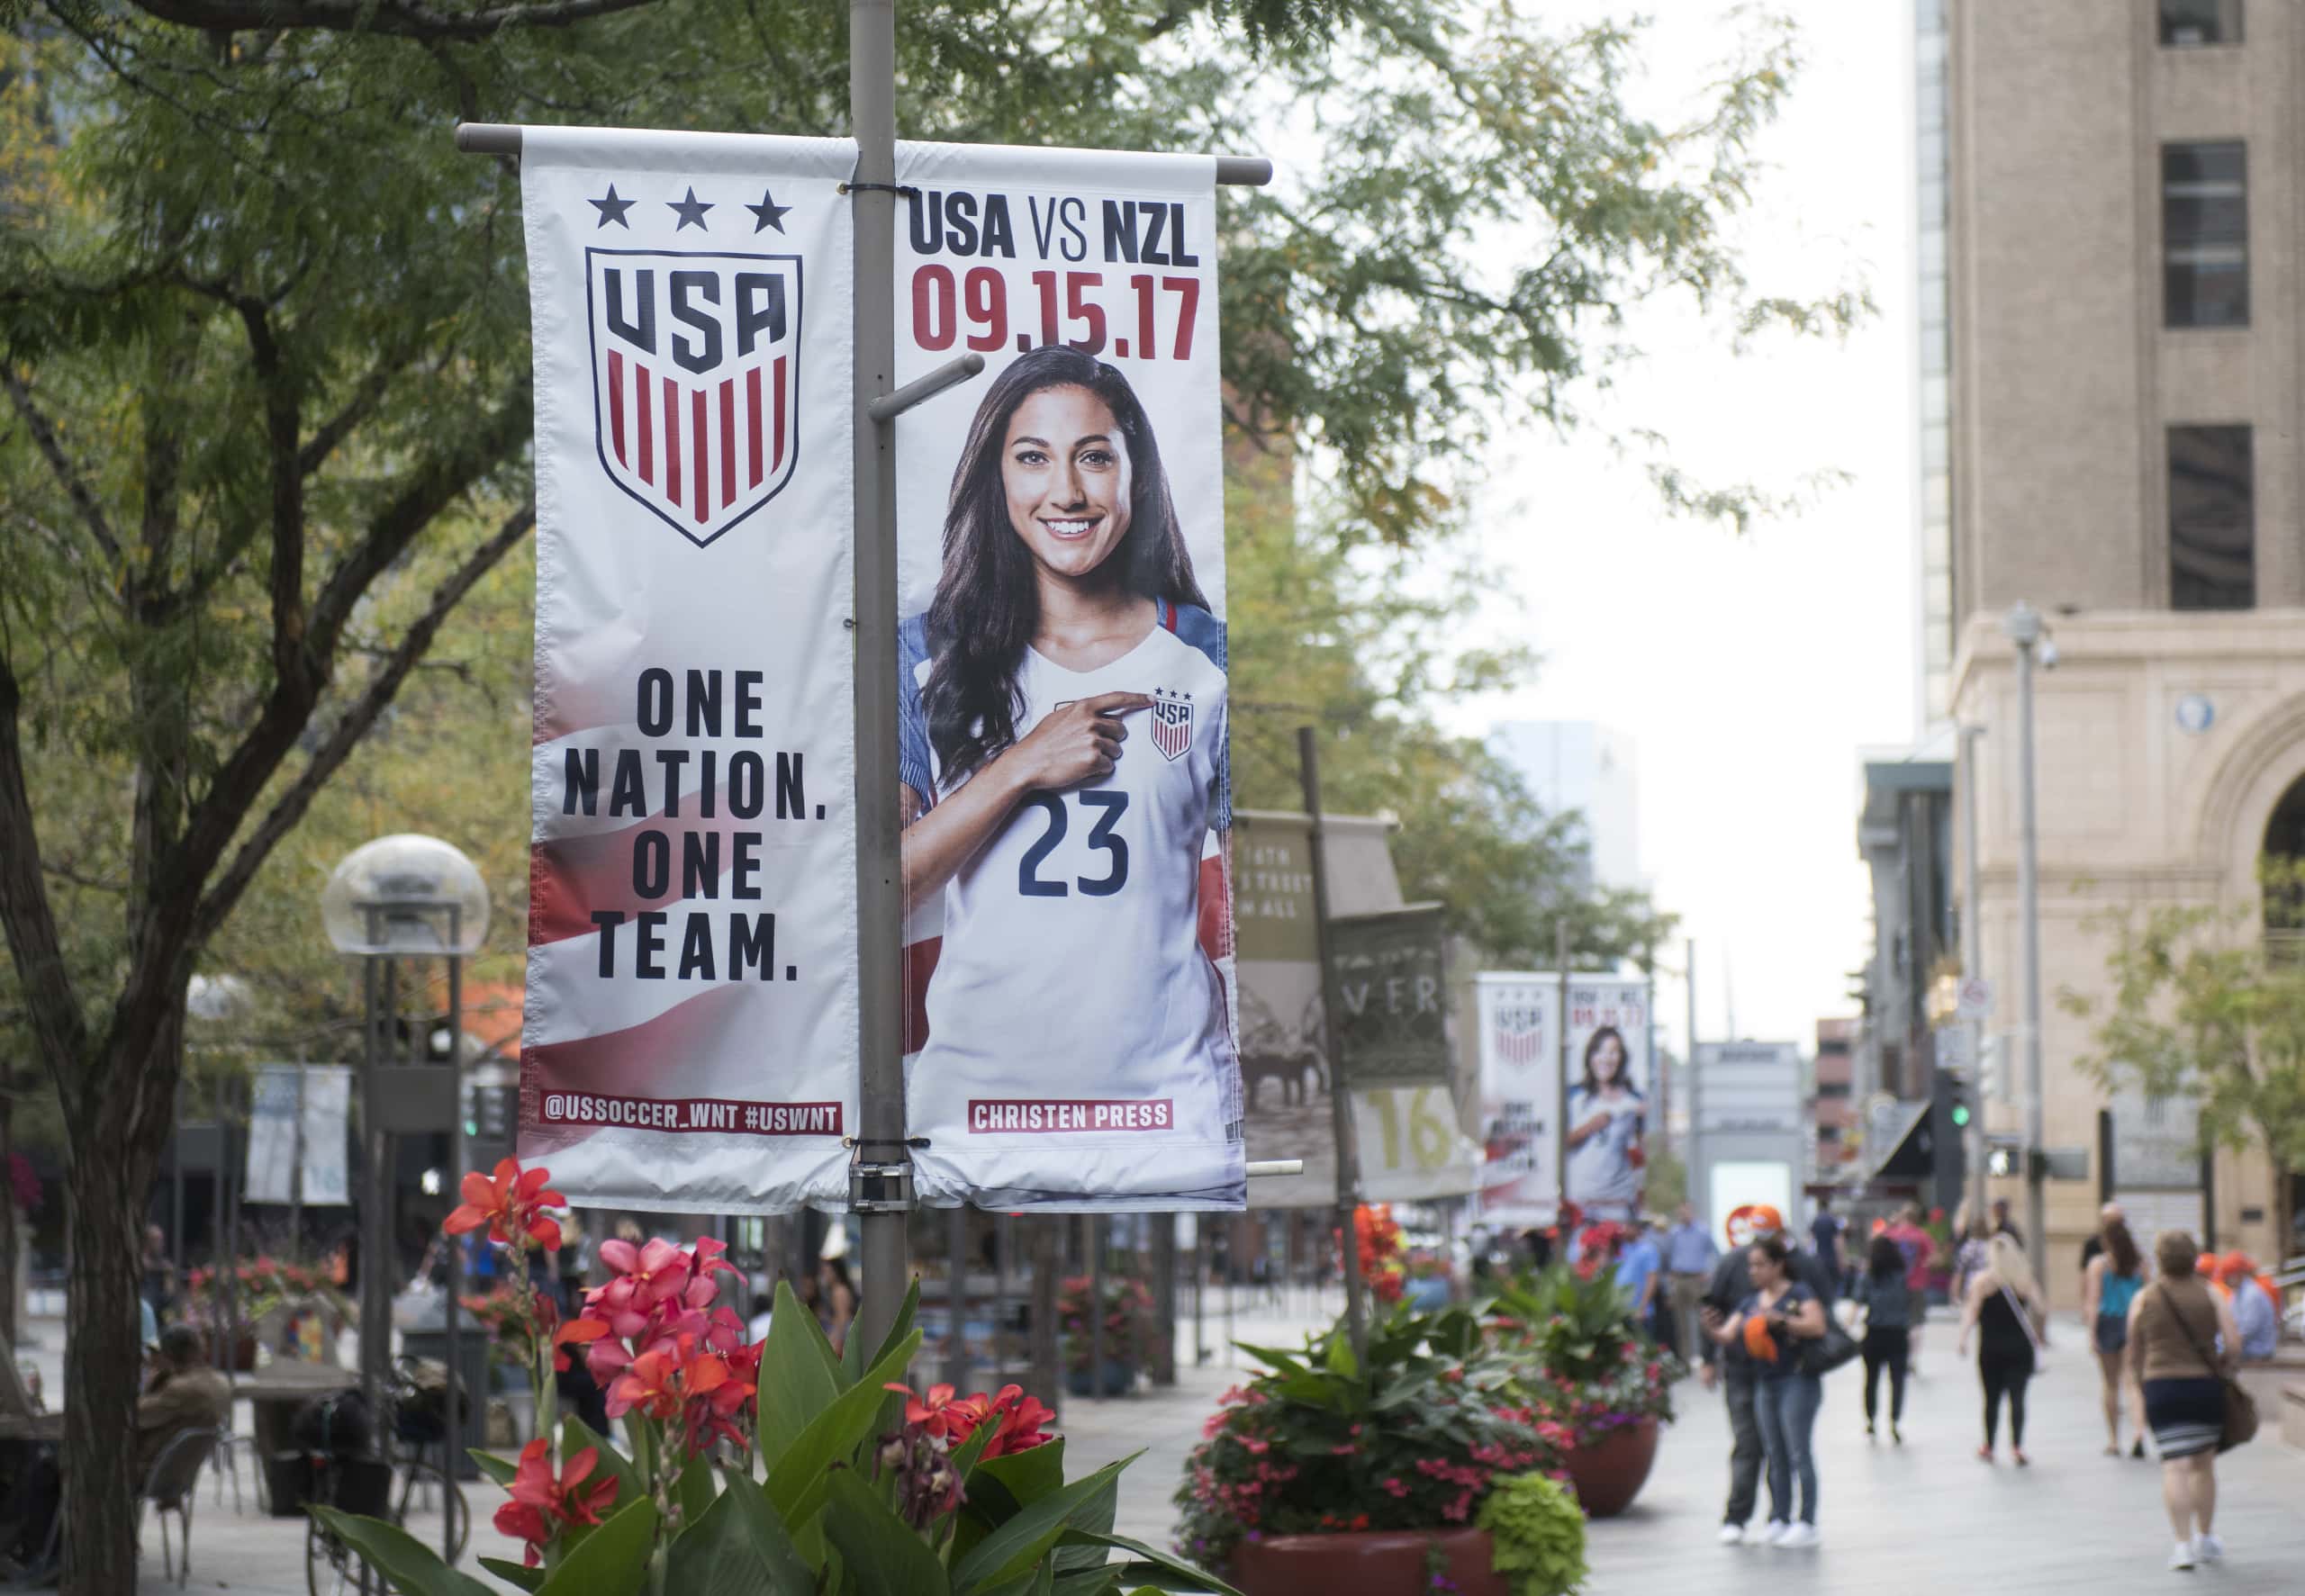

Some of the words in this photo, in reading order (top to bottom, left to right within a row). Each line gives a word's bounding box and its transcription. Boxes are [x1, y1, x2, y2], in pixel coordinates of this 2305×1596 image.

[908, 190, 1017, 258] USA
[1028, 195, 1088, 262] VS
[1102, 200, 1199, 267] NZL
[603, 267, 787, 375] USA
[911, 264, 1200, 361] 09.15.17
[637, 667, 764, 738] ONE
[1155, 701, 1189, 725] USA
[562, 748, 826, 820] NATION.
[632, 830, 763, 900] ONE
[1018, 789, 1129, 897] 23
[591, 910, 798, 981] TEAM.
[545, 1094, 738, 1130] @USSOCCER_WNT
[745, 1106, 837, 1132] #USWNT
[974, 1104, 1086, 1130] CHRISTEN
[1095, 1103, 1169, 1127] PRESS
[1368, 1087, 1451, 1169] 16
